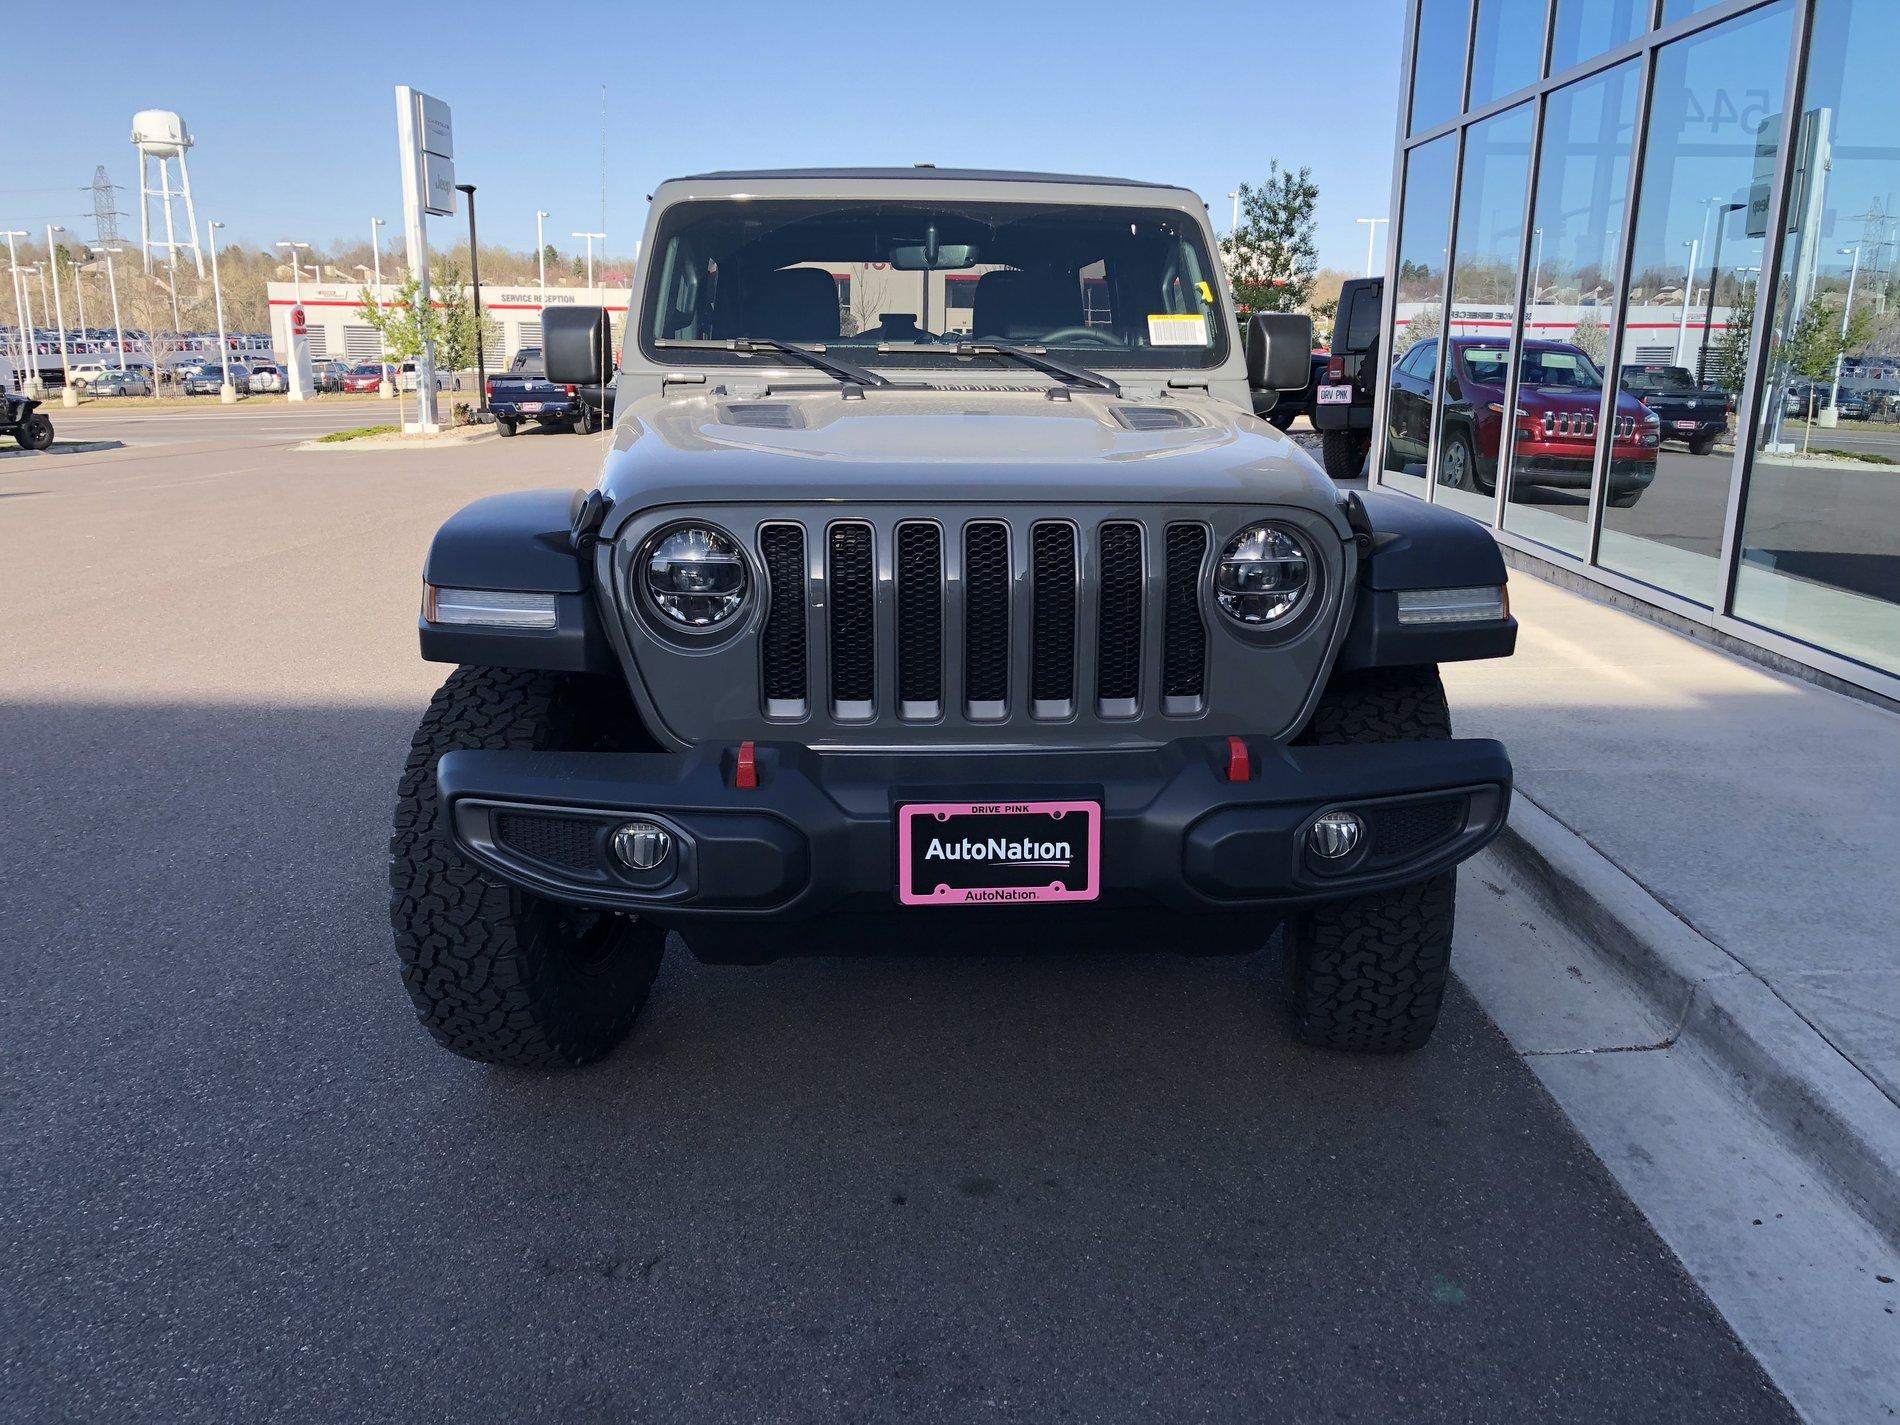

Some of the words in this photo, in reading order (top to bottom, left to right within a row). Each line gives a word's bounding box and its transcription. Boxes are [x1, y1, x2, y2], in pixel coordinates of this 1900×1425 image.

[501, 294, 532, 303] SERVICE
[971, 805, 1001, 814] DRIVE
[1004, 805, 1029, 813] PINK
[925, 837, 1071, 860] AutoNation
[965, 889, 1037, 901] AutoNation
